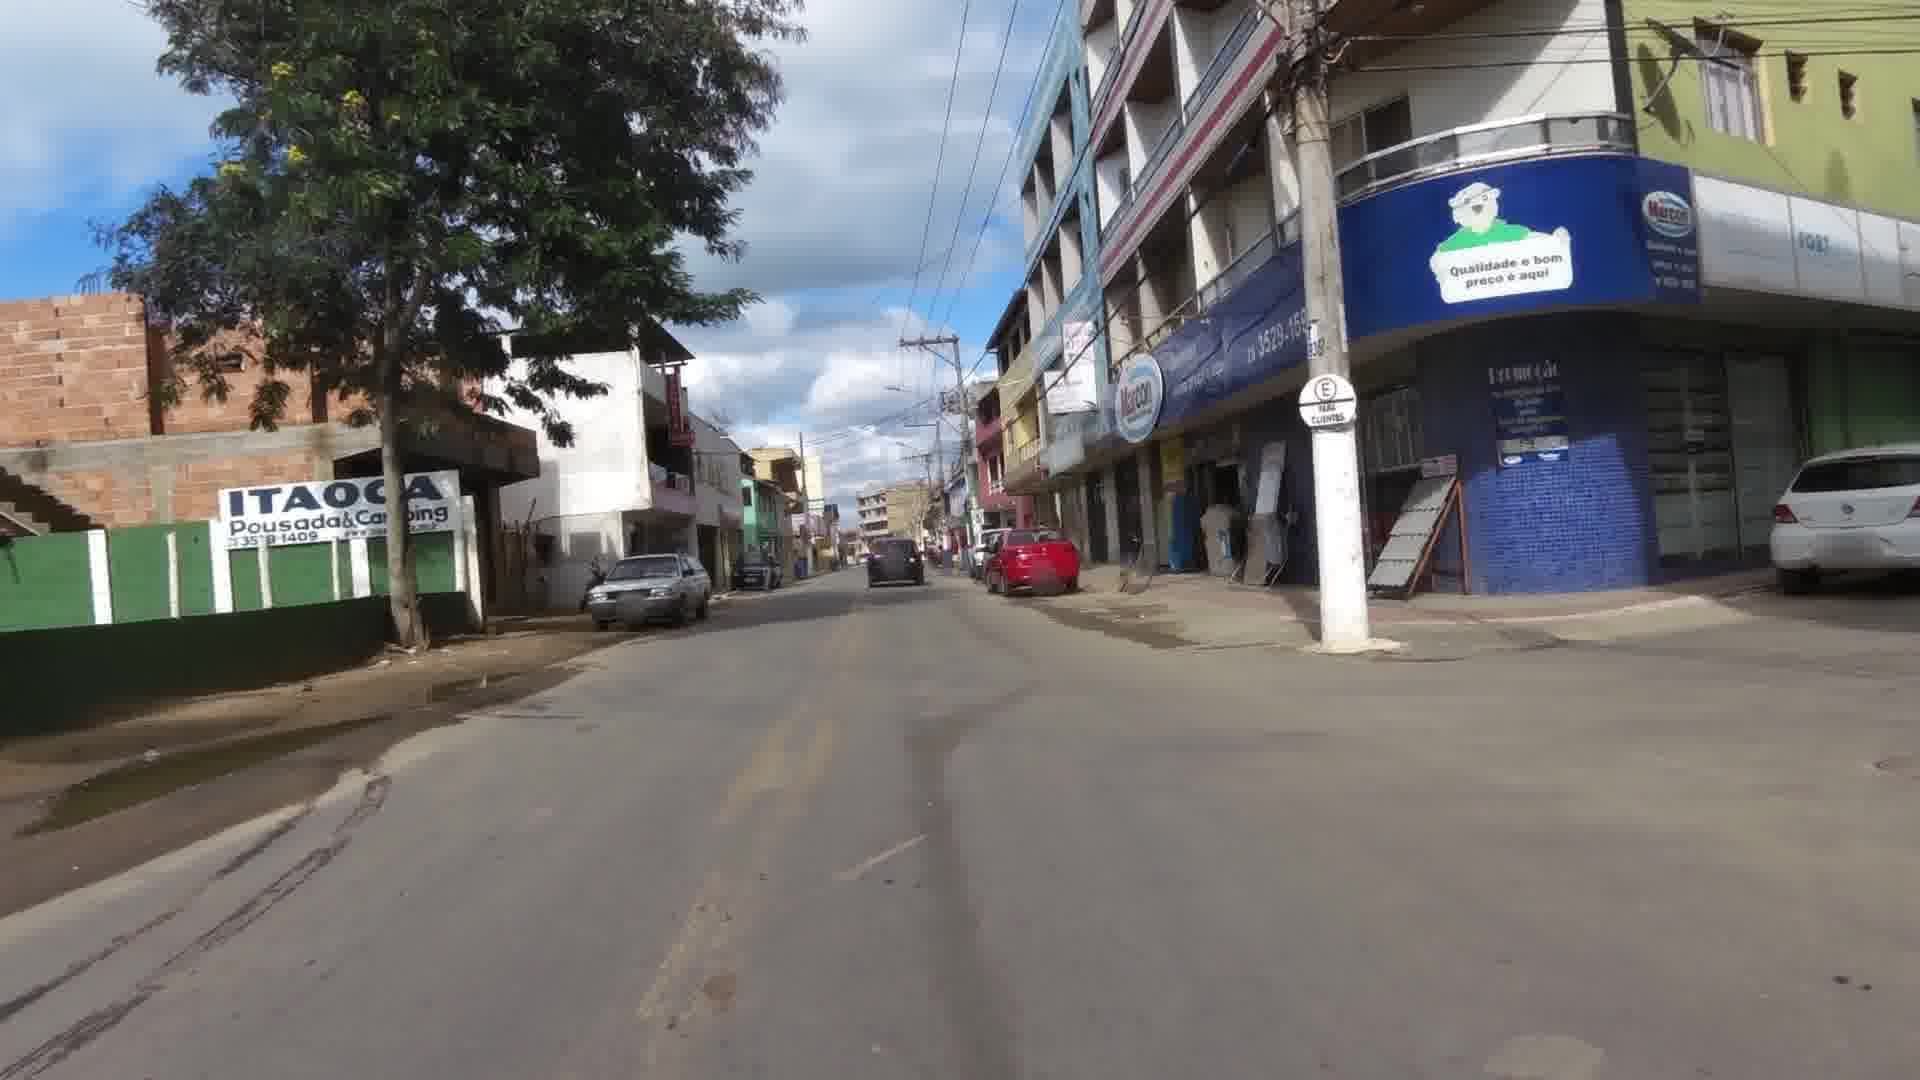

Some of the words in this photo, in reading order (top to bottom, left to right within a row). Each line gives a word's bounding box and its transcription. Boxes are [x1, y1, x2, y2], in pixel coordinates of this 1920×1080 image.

[1450, 258, 1517, 277] Qualidade
[1521, 258, 1530, 266] e
[1534, 255, 1562, 265] bom
[1520, 267, 1549, 280] aqui
[1321, 382, 1331, 397] E
